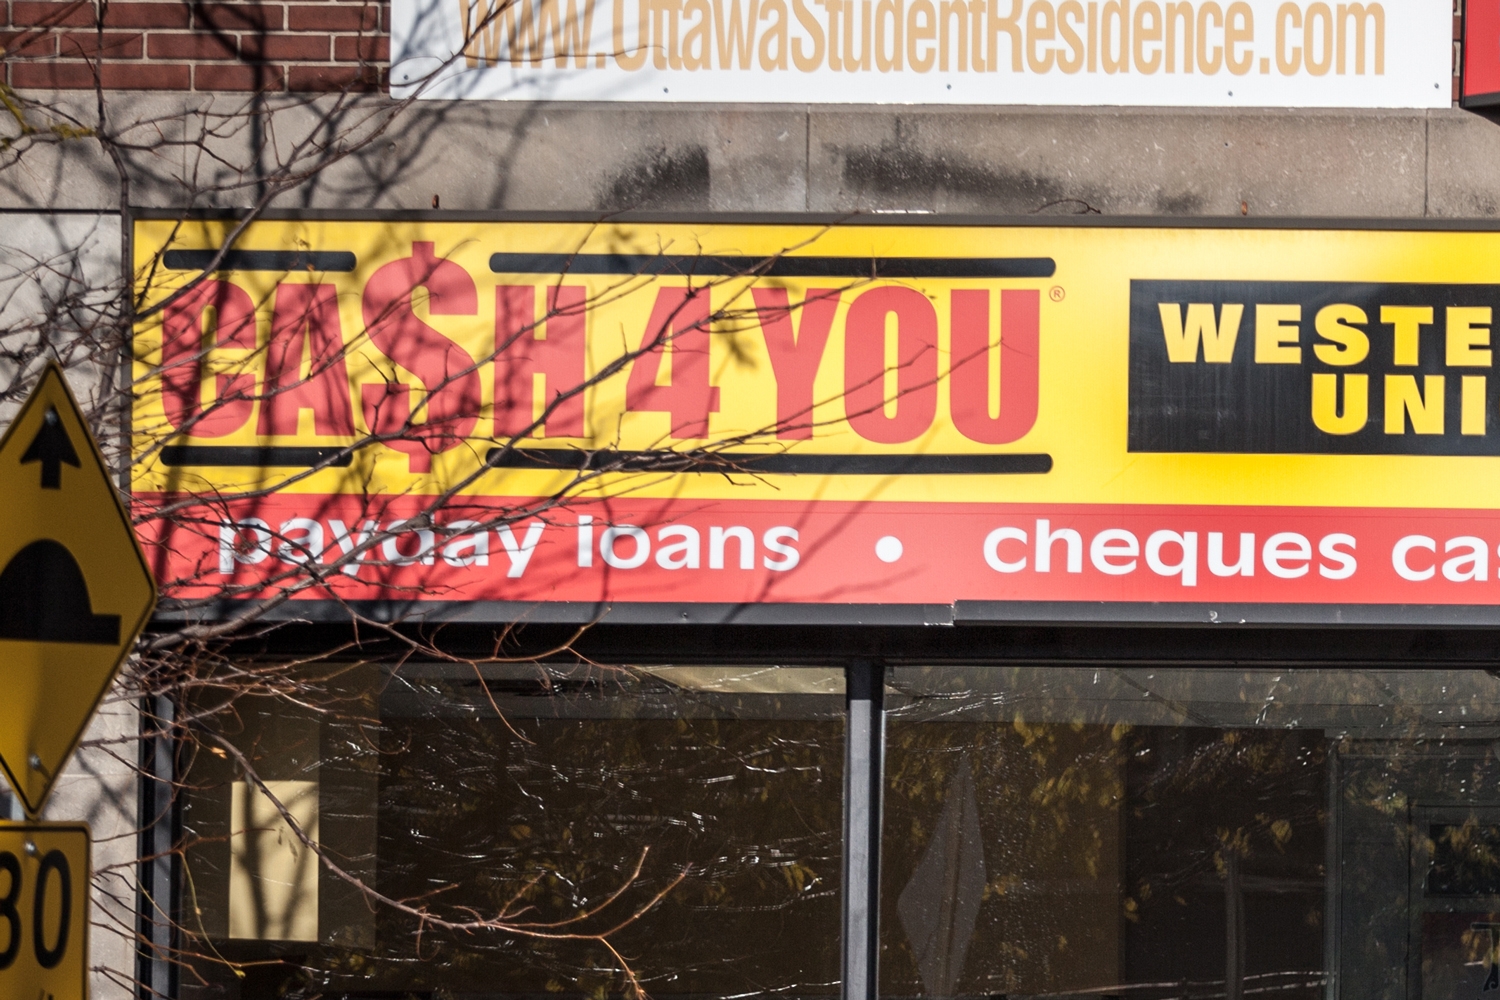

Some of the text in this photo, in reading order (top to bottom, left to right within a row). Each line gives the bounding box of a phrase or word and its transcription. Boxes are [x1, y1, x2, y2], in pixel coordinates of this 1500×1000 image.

[161, 241, 1040, 473] CA$H 4 YOU
[218, 514, 545, 578] payday
[577, 514, 801, 572] loans
[983, 518, 1357, 587] cheques
